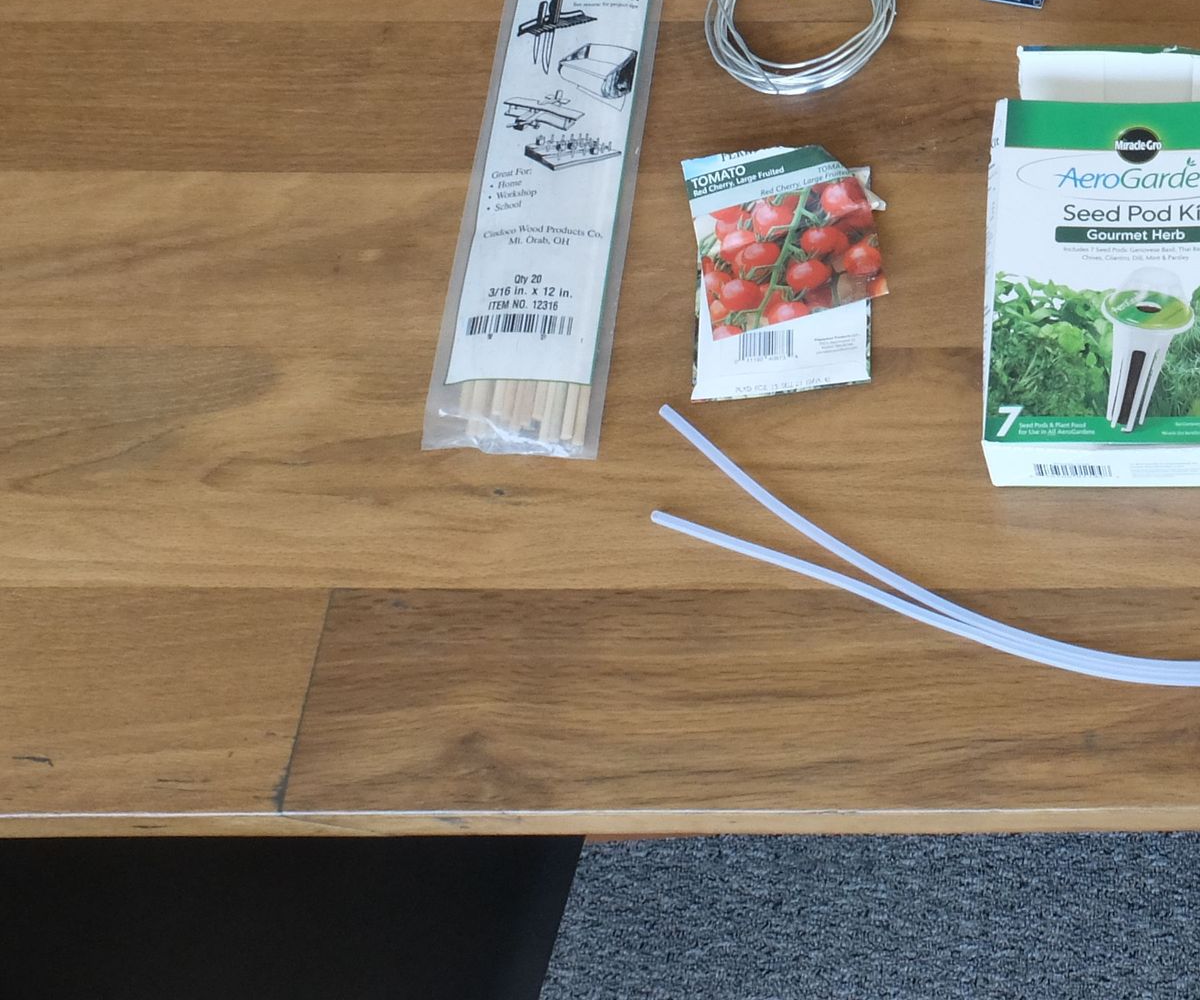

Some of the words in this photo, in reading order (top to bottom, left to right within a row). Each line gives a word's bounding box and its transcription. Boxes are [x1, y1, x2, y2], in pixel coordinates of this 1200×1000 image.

[491, 169, 513, 180] Great
[515, 167, 533, 176] For:
[690, 165, 746, 189] TOMATO
[497, 180, 523, 190] Home
[693, 186, 708, 198] Red
[708, 179, 735, 194] Cherry,
[736, 173, 757, 186] Large
[757, 165, 785, 179] Fruited
[760, 187, 774, 197] Red
[803, 174, 824, 186] Large
[496, 188, 537, 200] Workshop
[494, 200, 522, 212] School
[1063, 204, 1121, 222] Seed
[1128, 204, 1172, 222] Pod
[518, 224, 544, 233] Wood
[546, 225, 585, 237] Products
[1086, 228, 1148, 241] Gourmet
[1151, 228, 1186, 241] Herb
[508, 237, 523, 245] Mt.
[525, 235, 551, 246] Orab,
[553, 236, 570, 246] OH
[514, 274, 529, 285] Qty
[530, 274, 543, 284] 20
[488, 286, 511, 297] 3/16
[514, 287, 527, 295] in.
[531, 287, 539, 295] x
[543, 286, 556, 297] 12
[559, 287, 573, 299] in.
[487, 300, 510, 310] ITEM
[512, 299, 528, 310] NO.
[533, 300, 559, 311] 12316
[996, 405, 1024, 437] 7
